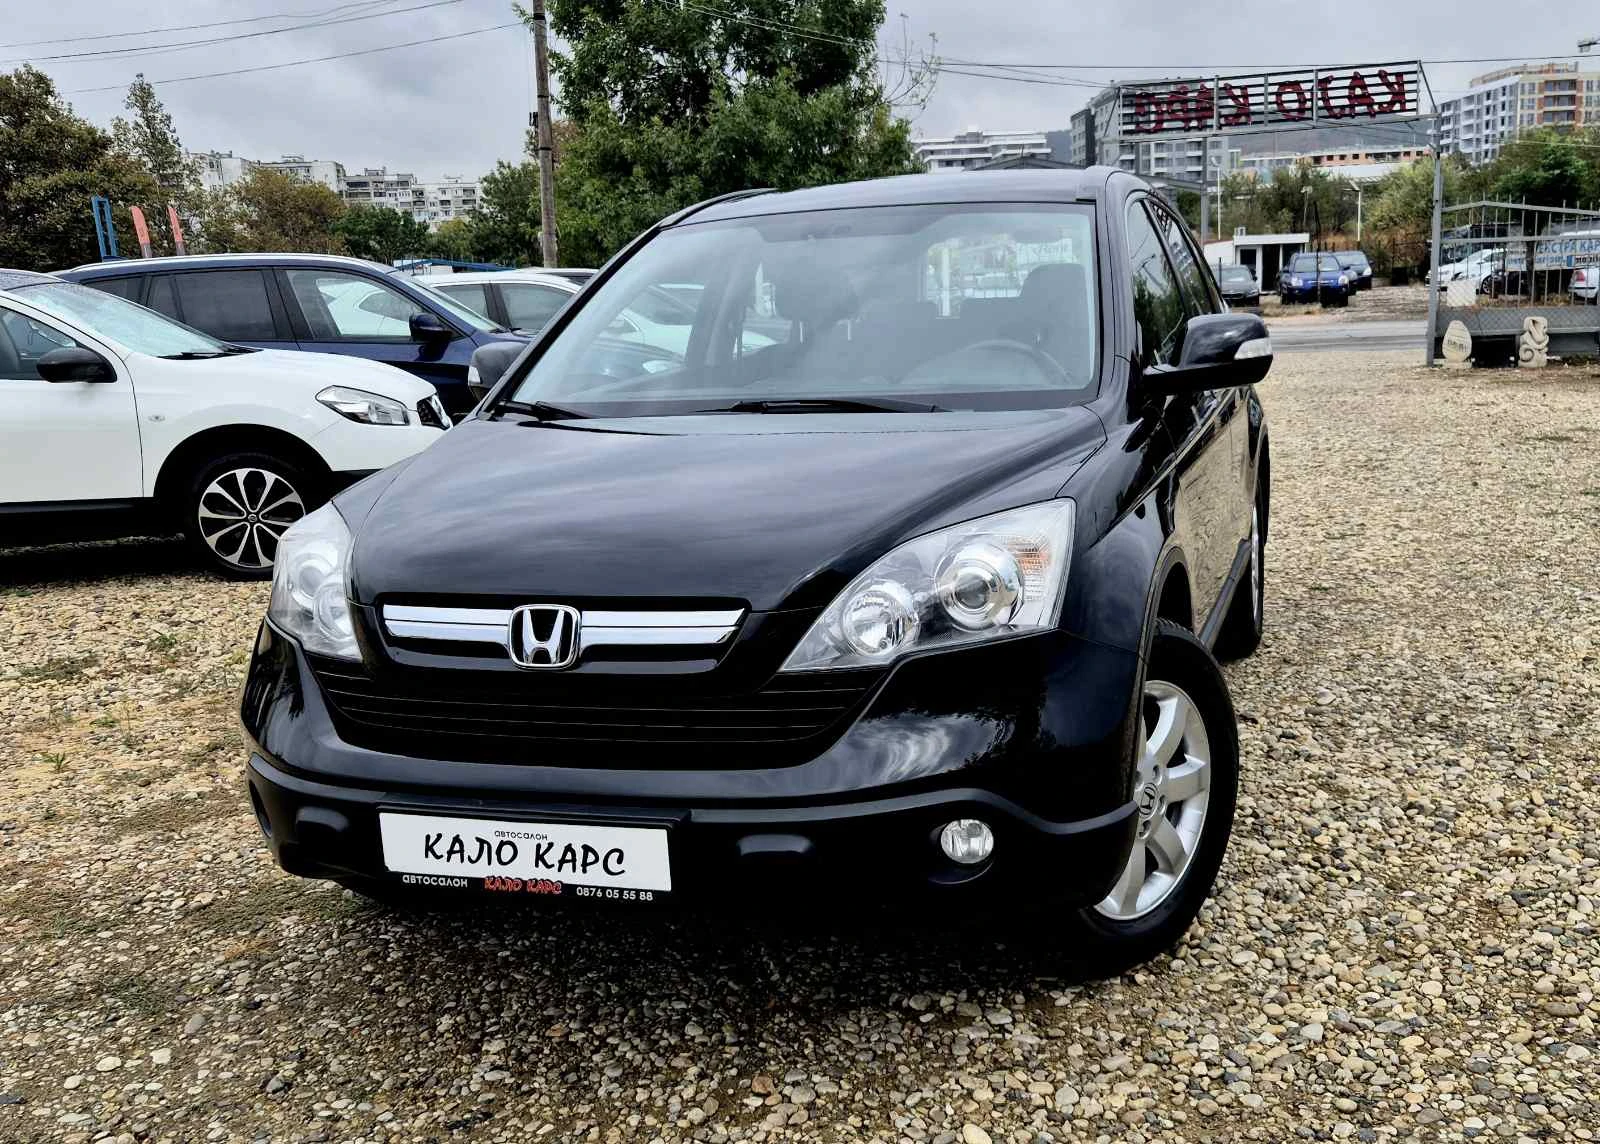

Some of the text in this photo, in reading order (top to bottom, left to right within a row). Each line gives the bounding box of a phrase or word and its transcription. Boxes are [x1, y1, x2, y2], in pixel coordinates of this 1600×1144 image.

[494, 829, 549, 842] автосалон
[424, 832, 626, 877] КАЛО КАРС
[402, 874, 654, 901] автосалон КАЛО КАРС 0876 05 55 88
